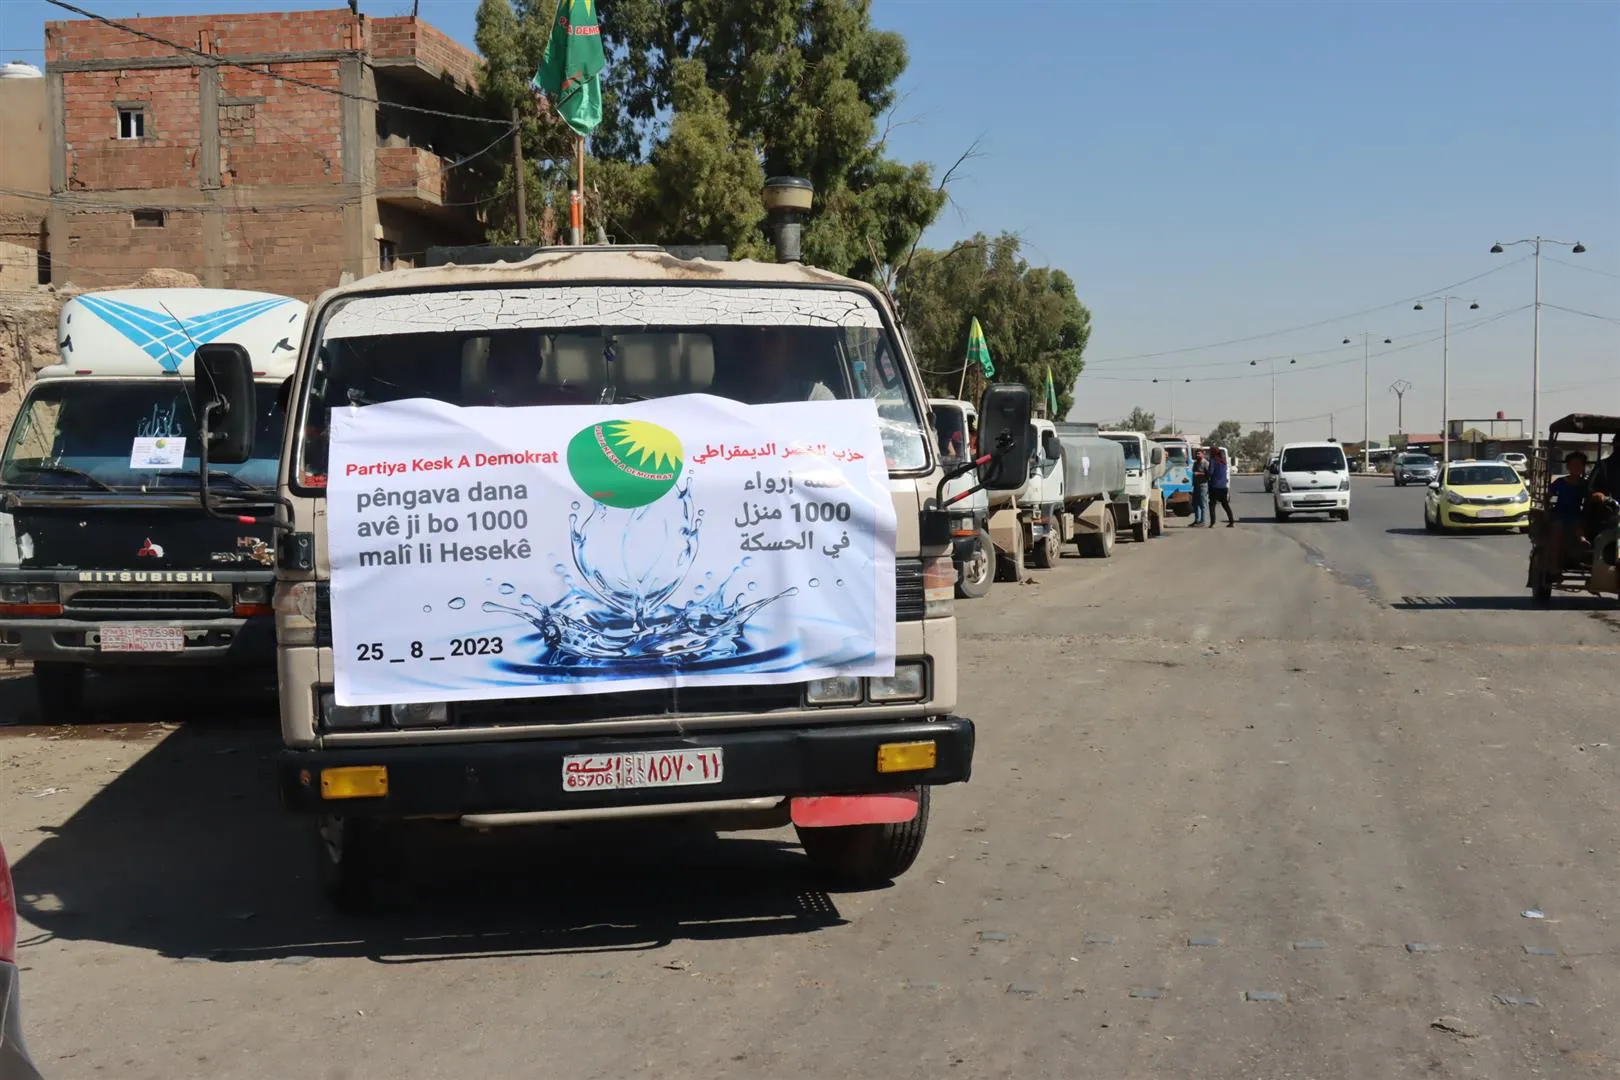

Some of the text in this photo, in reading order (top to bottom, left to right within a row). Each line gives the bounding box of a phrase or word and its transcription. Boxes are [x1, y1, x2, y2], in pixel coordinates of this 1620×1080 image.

[345, 450, 559, 477] Partiya Kesk A Demokrat
[692, 443, 777, 464] الديمقراطي
[832, 448, 864, 462] حزب
[357, 482, 528, 513] pêngava dana
[357, 509, 528, 540] avê ji bo 1000
[734, 502, 851, 528] 1000 منزل
[359, 539, 532, 567] malî li Hesekê
[739, 530, 851, 559] في الحسكة
[79, 571, 213, 582] MITSUBISHI
[357, 642, 384, 661] 25
[410, 641, 423, 659] 8
[450, 637, 503, 656] 2023
